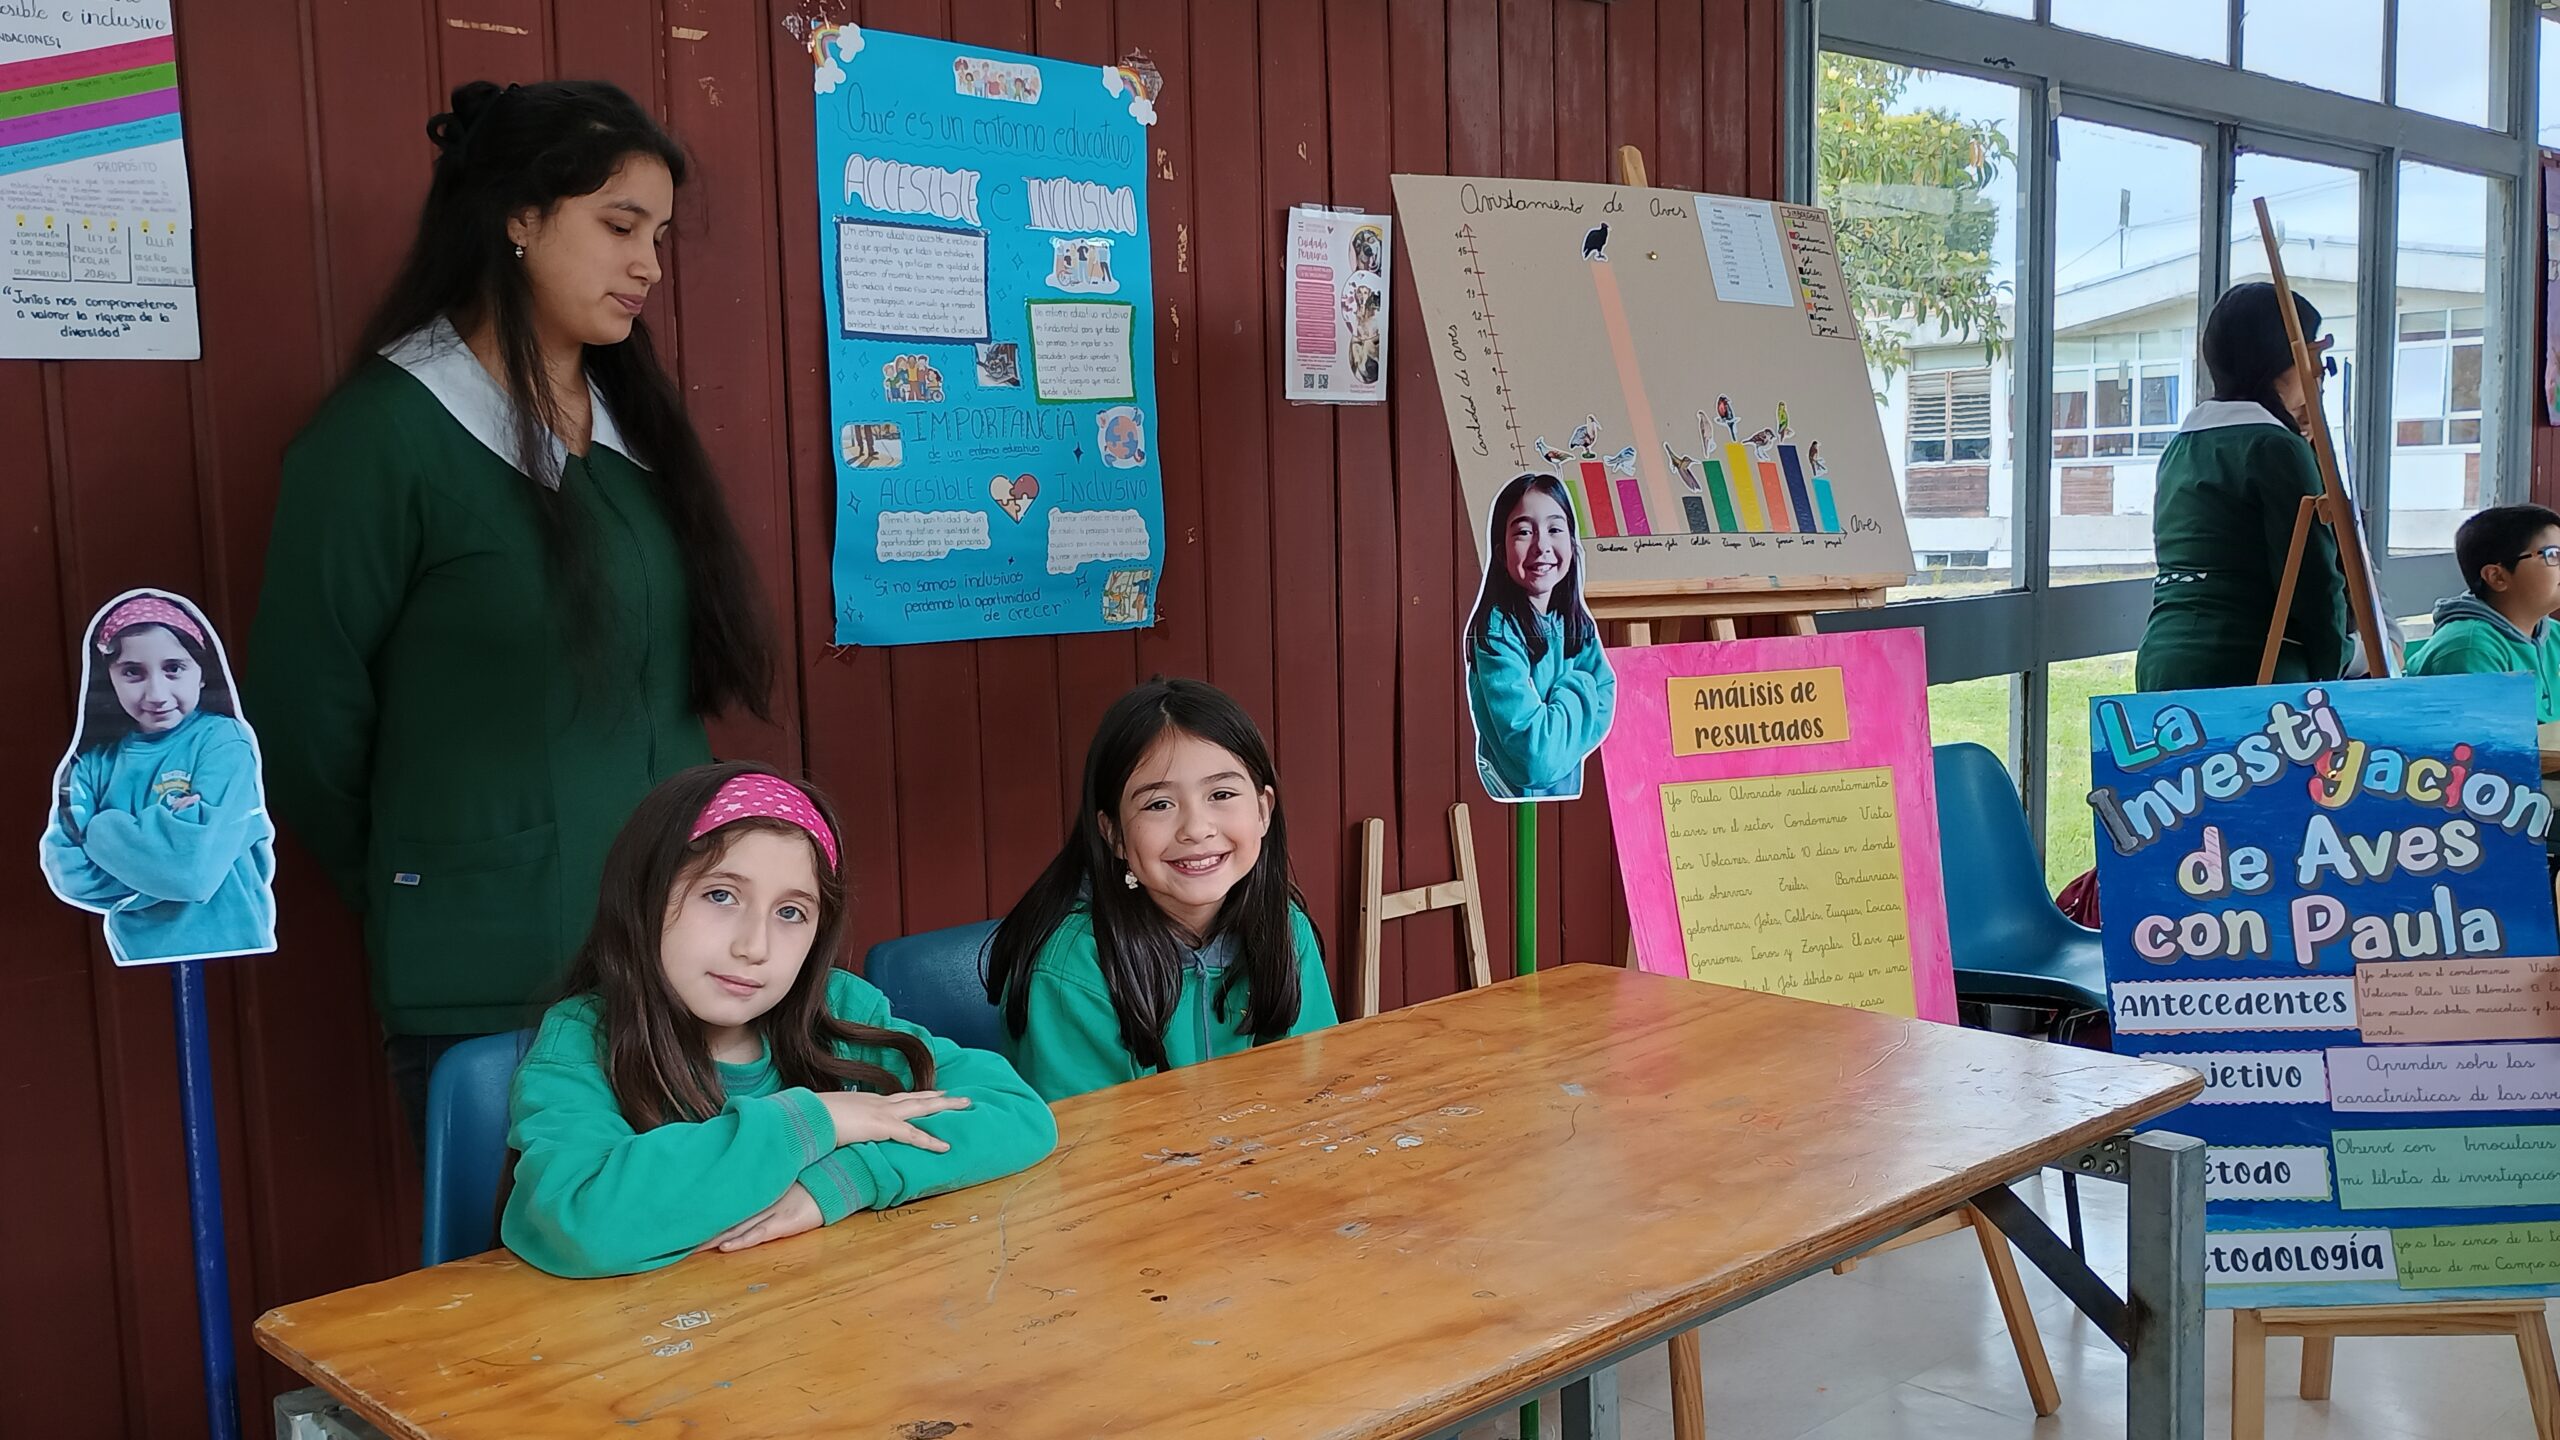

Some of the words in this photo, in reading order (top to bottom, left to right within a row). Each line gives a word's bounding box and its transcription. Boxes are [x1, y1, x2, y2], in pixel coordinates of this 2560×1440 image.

[0, 0, 48, 20] esible
[62, 11, 73, 22] e
[82, 8, 166, 30] inclusivo
[906, 111, 933, 139] es
[941, 116, 964, 143] un
[974, 114, 1046, 152] entorno
[1054, 109, 1130, 164] educativo
[1603, 192, 1624, 213] de
[1650, 198, 1687, 218] Aves
[86, 298, 177, 310] comprometemos
[1467, 289, 1475, 298] 13
[77, 311, 87, 320] la
[140, 313, 152, 322] de
[160, 313, 169, 322] la
[1472, 311, 1482, 320] 12
[1478, 330, 1487, 338] 11
[1455, 369, 1470, 386] de
[928, 446, 941, 459] de
[948, 450, 962, 458] un
[969, 445, 998, 457] entorno
[1003, 443, 1040, 454] educativo
[894, 583, 910, 593] no
[917, 579, 956, 592] somos
[965, 571, 1023, 588] inclusivos
[904, 600, 954, 620] perdemos
[958, 594, 970, 608] la
[975, 588, 1040, 607] oportunidad
[984, 610, 1000, 622] de
[1791, 681, 1817, 703] de
[1695, 717, 1824, 749] resultados
[2099, 702, 2197, 768] La
[1665, 792, 1681, 812] Yo
[1691, 788, 1721, 803] Paula
[1730, 784, 1782, 800] Alvarado
[1787, 781, 1818, 796] realicé
[1820, 776, 1888, 793] avistamiento
[1670, 827, 1681, 838] de
[1683, 826, 1707, 837] aves
[1713, 826, 1725, 834] en
[1731, 819, 1739, 832] el
[1744, 817, 1773, 831] sector
[1784, 813, 1848, 828] Condominio
[1859, 806, 1892, 820] Vista
[1676, 856, 1694, 870] Los
[1755, 846, 1795, 863] durante
[1801, 847, 1810, 858] 10
[1862, 836, 1895, 852] donde
[2177, 826, 2269, 894] de
[2297, 815, 2479, 884] Aves
[1681, 889, 1704, 908] pude
[1710, 885, 1752, 899] observar
[2134, 910, 2266, 958] con
[2291, 886, 2499, 964] Paula
[1752, 946, 1779, 960] Loros
[1785, 950, 1792, 962] y
[1852, 933, 1861, 946] El
[1864, 937, 1882, 945] ave
[1887, 934, 1904, 948] que
[1763, 977, 1770, 991] el
[1778, 974, 1798, 994] Jote
[1803, 970, 1833, 986] debido
[1835, 973, 1843, 981] a
[1849, 970, 1864, 985] que
[1885, 964, 1908, 973] una
[2436, 967, 2444, 976] el
[1860, 998, 1884, 1007] casa
[2120, 986, 2347, 1017] Antecedentes
[2205, 1061, 2302, 1088] jetivo
[2367, 1054, 2447, 1078] Aprender
[2456, 1053, 2497, 1069] sobre
[2506, 1052, 2536, 1068] las
[2337, 1087, 2460, 1104] características
[2470, 1085, 2488, 1101] de
[2498, 1085, 2526, 1100] las
[2530, 1089, 2560, 1100] ave
[2336, 1138, 2394, 1154] Observé
[2403, 1142, 2435, 1153] con
[2464, 1134, 2556, 1151] binoculares
[2205, 1156, 2291, 1185] étodo
[2341, 1176, 2362, 1186] mi
[2372, 1169, 2423, 1185] libreta
[2432, 1168, 2449, 1184] de
[2459, 1168, 2560, 1188] investigació
[2205, 1233, 2384, 1272] todología
[2395, 1242, 2411, 1254] yo
[2415, 1240, 2426, 1248] a
[2433, 1234, 2455, 1248] las
[2463, 1236, 2497, 1246] cinco
[2507, 1231, 2521, 1244] de
[2528, 1231, 2543, 1243] la
[2400, 1263, 2440, 1280] afuera
[2448, 1260, 2463, 1272] de
[2470, 1263, 2489, 1272] mi
[2495, 1257, 2545, 1274] Campo
